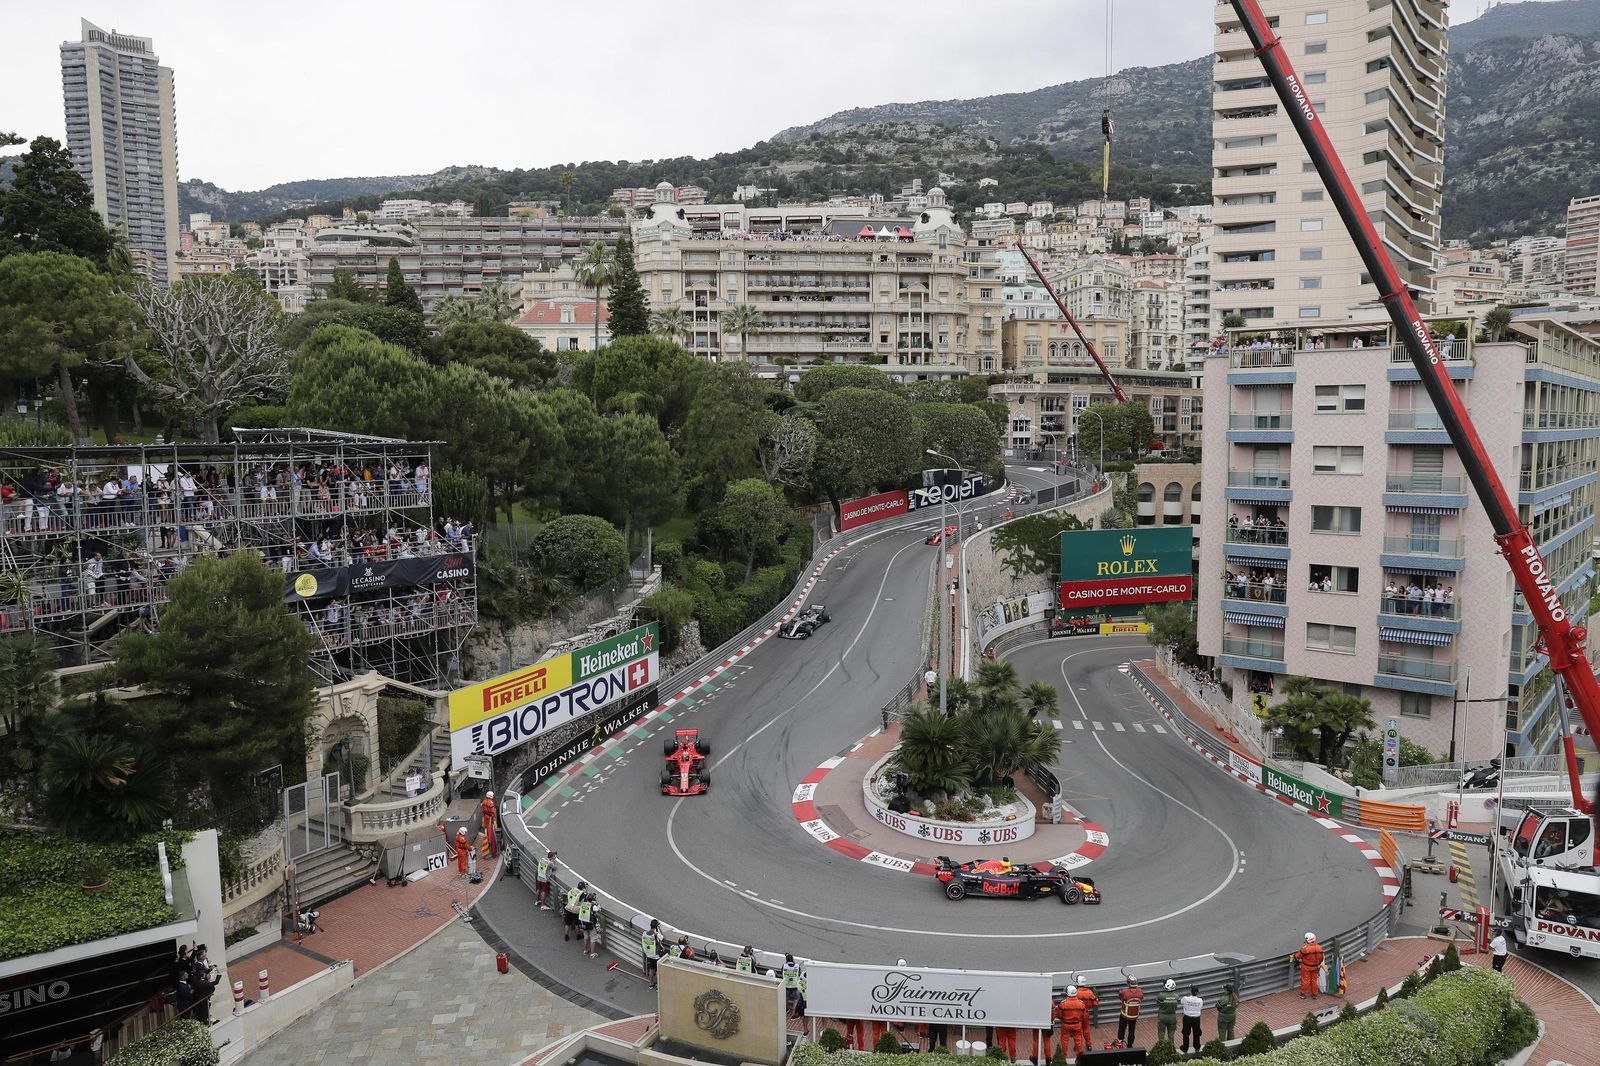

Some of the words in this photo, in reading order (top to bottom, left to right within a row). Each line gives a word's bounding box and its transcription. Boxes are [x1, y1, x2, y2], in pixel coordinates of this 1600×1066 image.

[1286, 74, 1314, 121] PIOVANO
[1412, 320, 1439, 365] PIOVANO
[844, 509, 860, 521] CASINO
[436, 568, 469, 579] CASINO
[1097, 559, 1158, 576] ROLEX
[359, 575, 386, 583] CASINO
[1520, 544, 1565, 622] PIOVANO
[1068, 590, 1104, 599] CASINO
[1105, 588, 1119, 597] DE
[1120, 584, 1187, 596] MONTE-CARLO
[580, 641, 638, 678] Heineken
[482, 667, 548, 713] PIRELLI
[487, 668, 626, 752] BIOPTRON
[533, 738, 589, 785] JOHNNIE
[603, 702, 649, 735] WALKER
[1267, 770, 1314, 806] Heineken
[883, 813, 906, 831] UBS
[813, 826, 834, 841] UBS
[933, 827, 963, 841] UBS
[993, 828, 1018, 842] UBS
[1448, 831, 1490, 844] PIOVANO
[428, 854, 446, 871] FCY
[883, 857, 913, 870] UBS
[1064, 854, 1086, 865] UBS
[1537, 921, 1600, 942] PIOVAN
[871, 971, 987, 1007] Fairmont
[870, 1004, 927, 1017] MONTE
[932, 1007, 987, 1020] CARLO
